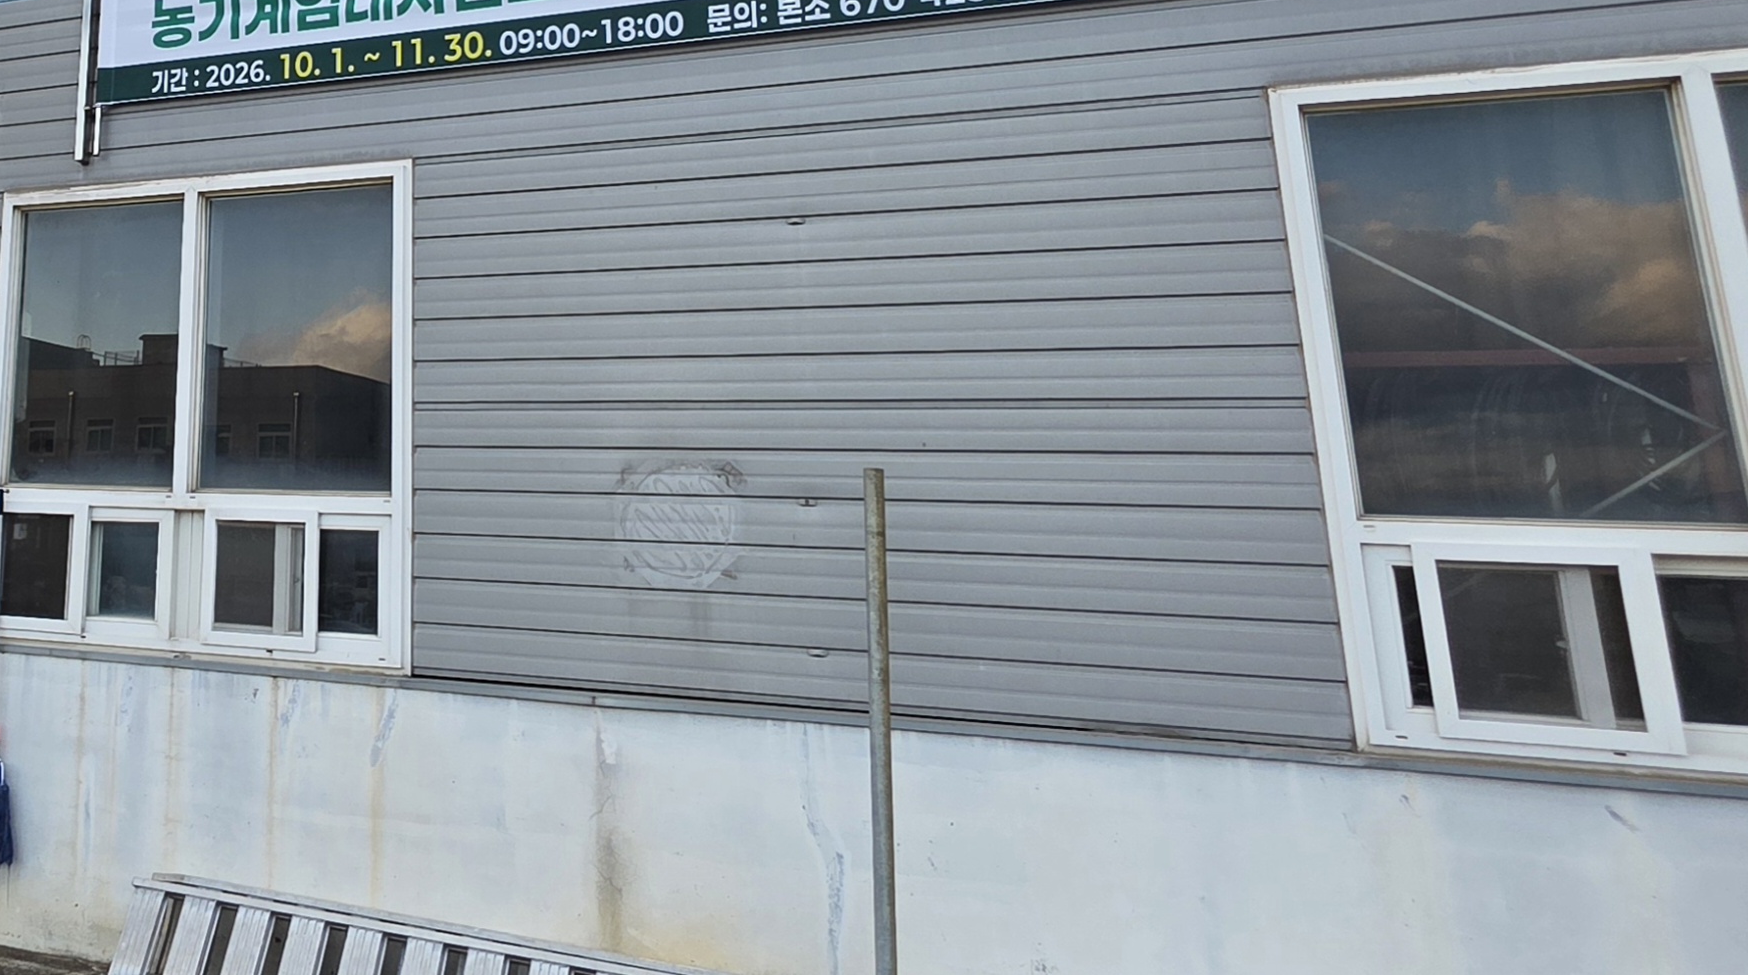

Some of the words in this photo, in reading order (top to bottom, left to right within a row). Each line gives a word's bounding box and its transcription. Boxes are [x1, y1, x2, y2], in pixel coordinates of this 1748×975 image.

[206, 60, 271, 88] 2026.
[279, 52, 320, 79] 10.
[331, 47, 355, 73] 1.
[391, 39, 435, 68] 11.
[444, 31, 492, 62] 30.
[498, 11, 683, 56] 09:00~18:00
[706, 0, 767, 33] 문의:
